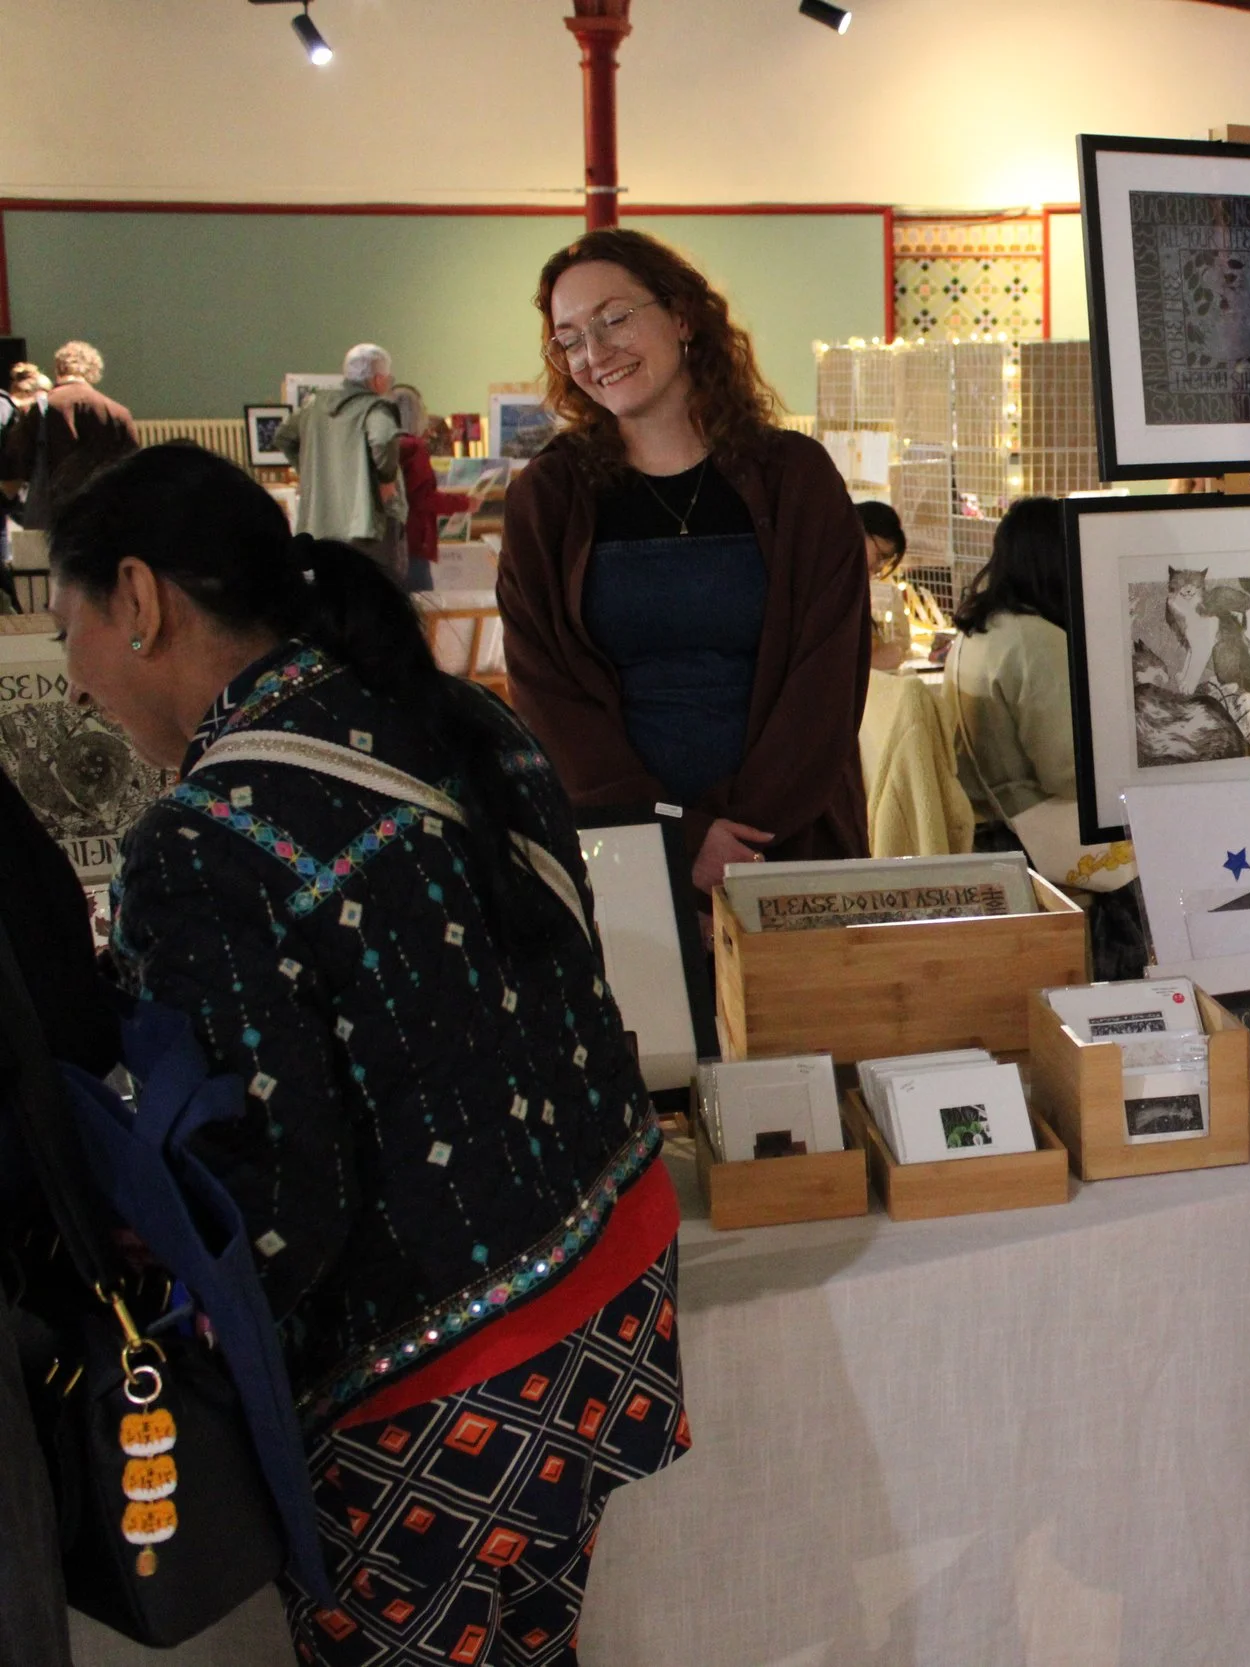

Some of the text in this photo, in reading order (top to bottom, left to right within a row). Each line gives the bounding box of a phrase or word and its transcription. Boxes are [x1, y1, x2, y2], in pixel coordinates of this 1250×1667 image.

[758, 887, 979, 917] PLEASE DO NOT ASK ME
